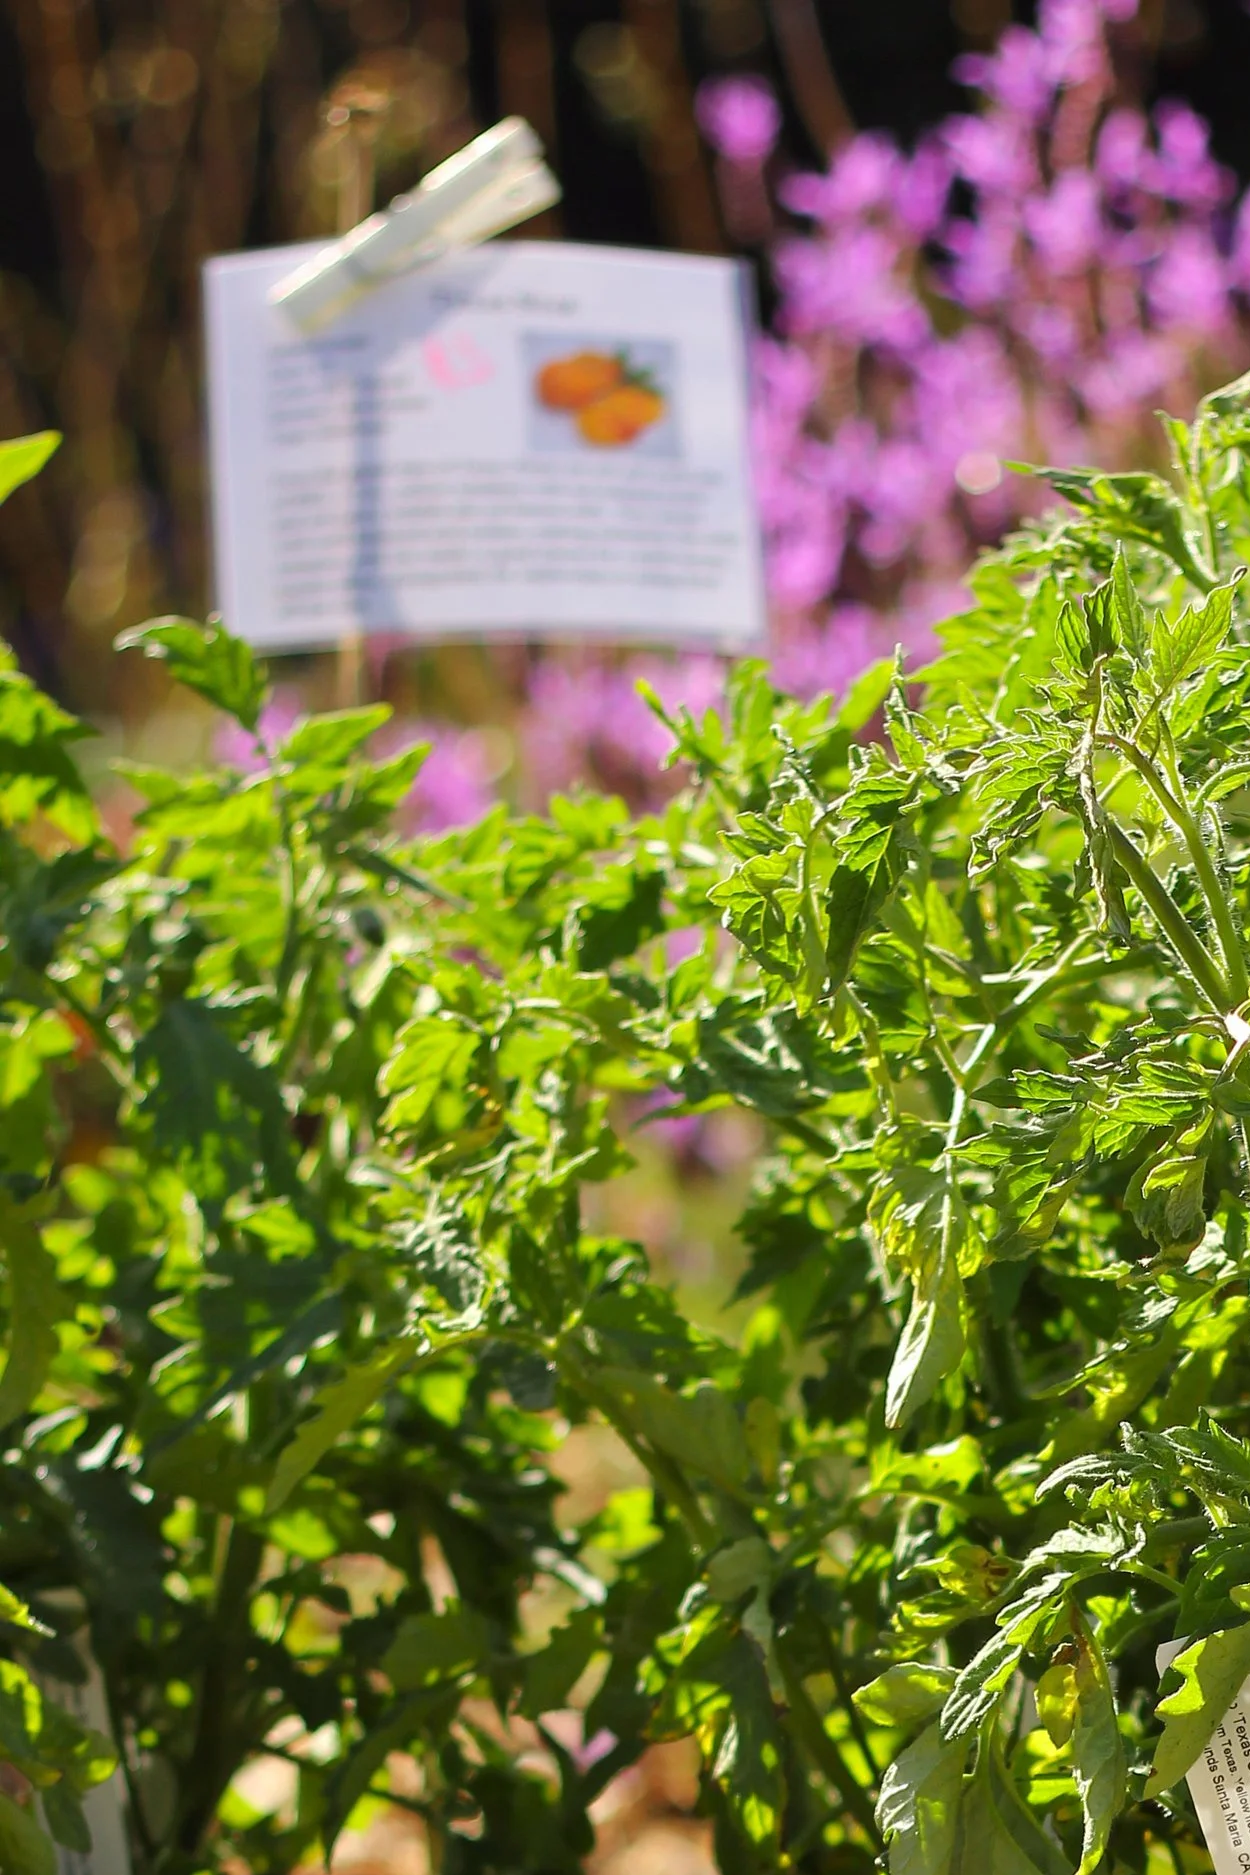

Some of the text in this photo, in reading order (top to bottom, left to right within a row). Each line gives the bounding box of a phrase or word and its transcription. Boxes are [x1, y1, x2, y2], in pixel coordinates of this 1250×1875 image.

[1213, 1775, 1231, 1810] Santa
[1225, 1812, 1242, 1847] Maria
[1235, 1777, 1250, 1813] Yellow
